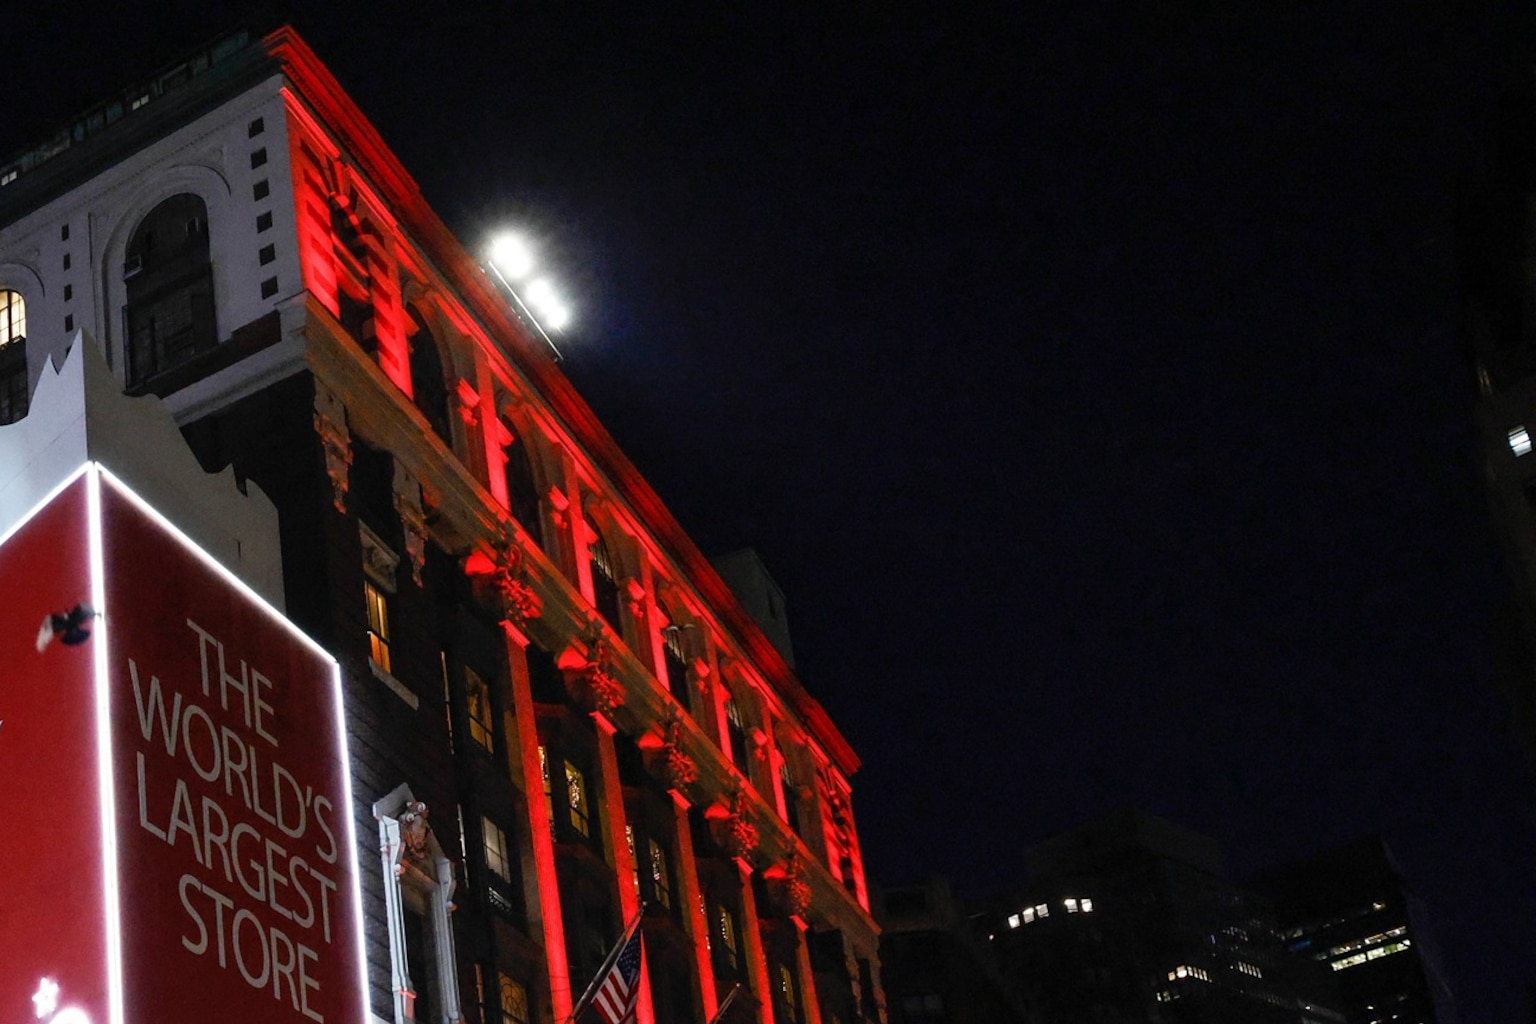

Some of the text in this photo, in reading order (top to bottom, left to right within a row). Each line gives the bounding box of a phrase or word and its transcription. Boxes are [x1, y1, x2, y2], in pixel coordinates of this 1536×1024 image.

[128, 658, 338, 865] WORLD'S
[186, 618, 279, 747] THE
[137, 751, 337, 945] LARGEST
[178, 873, 325, 1024] STORE
